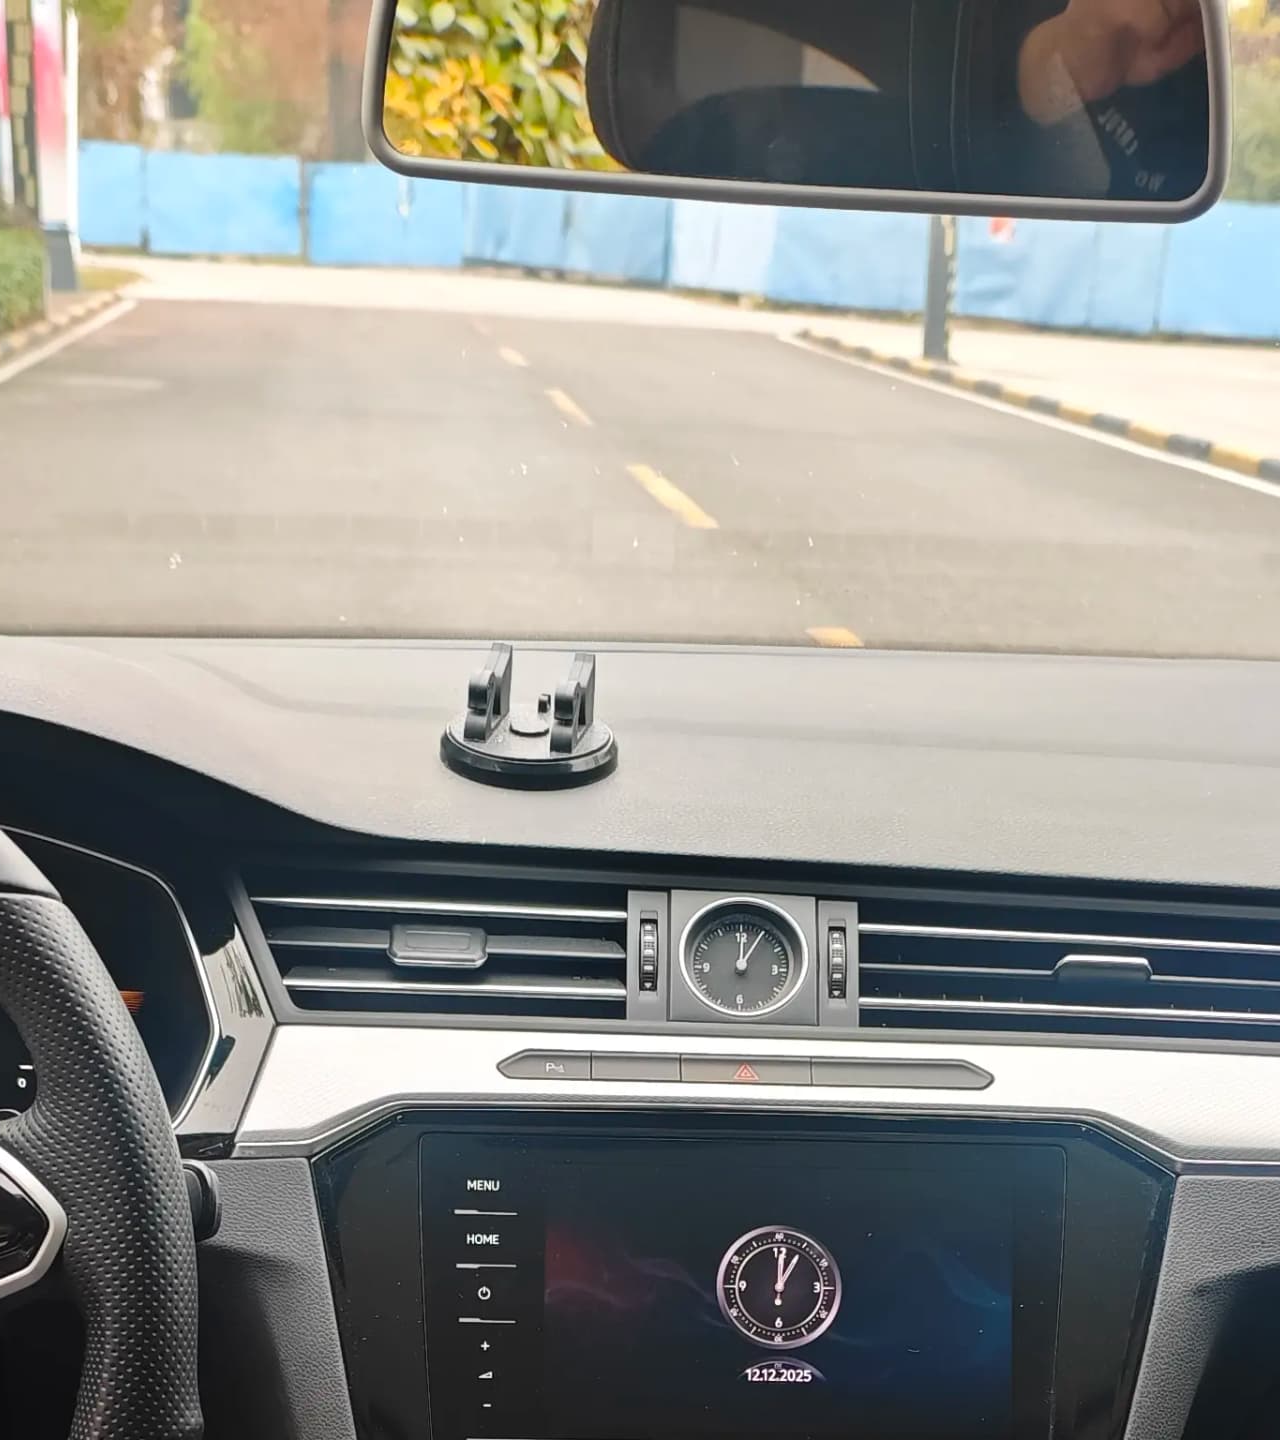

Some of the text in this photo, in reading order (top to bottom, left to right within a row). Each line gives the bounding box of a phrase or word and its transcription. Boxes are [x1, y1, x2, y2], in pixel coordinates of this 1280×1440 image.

[702, 962, 711, 973] 9
[771, 964, 778, 975] 3
[735, 993, 744, 1004] 6
[16, 1077, 27, 1089] 0
[466, 1179, 501, 1192] MENU
[466, 1233, 500, 1245] HOME
[772, 1247, 787, 1259] 12
[738, 1280, 747, 1292] 9
[812, 1281, 821, 1293] 3
[774, 1316, 783, 1328] 6
[746, 1368, 813, 1383] 12.12.2025
